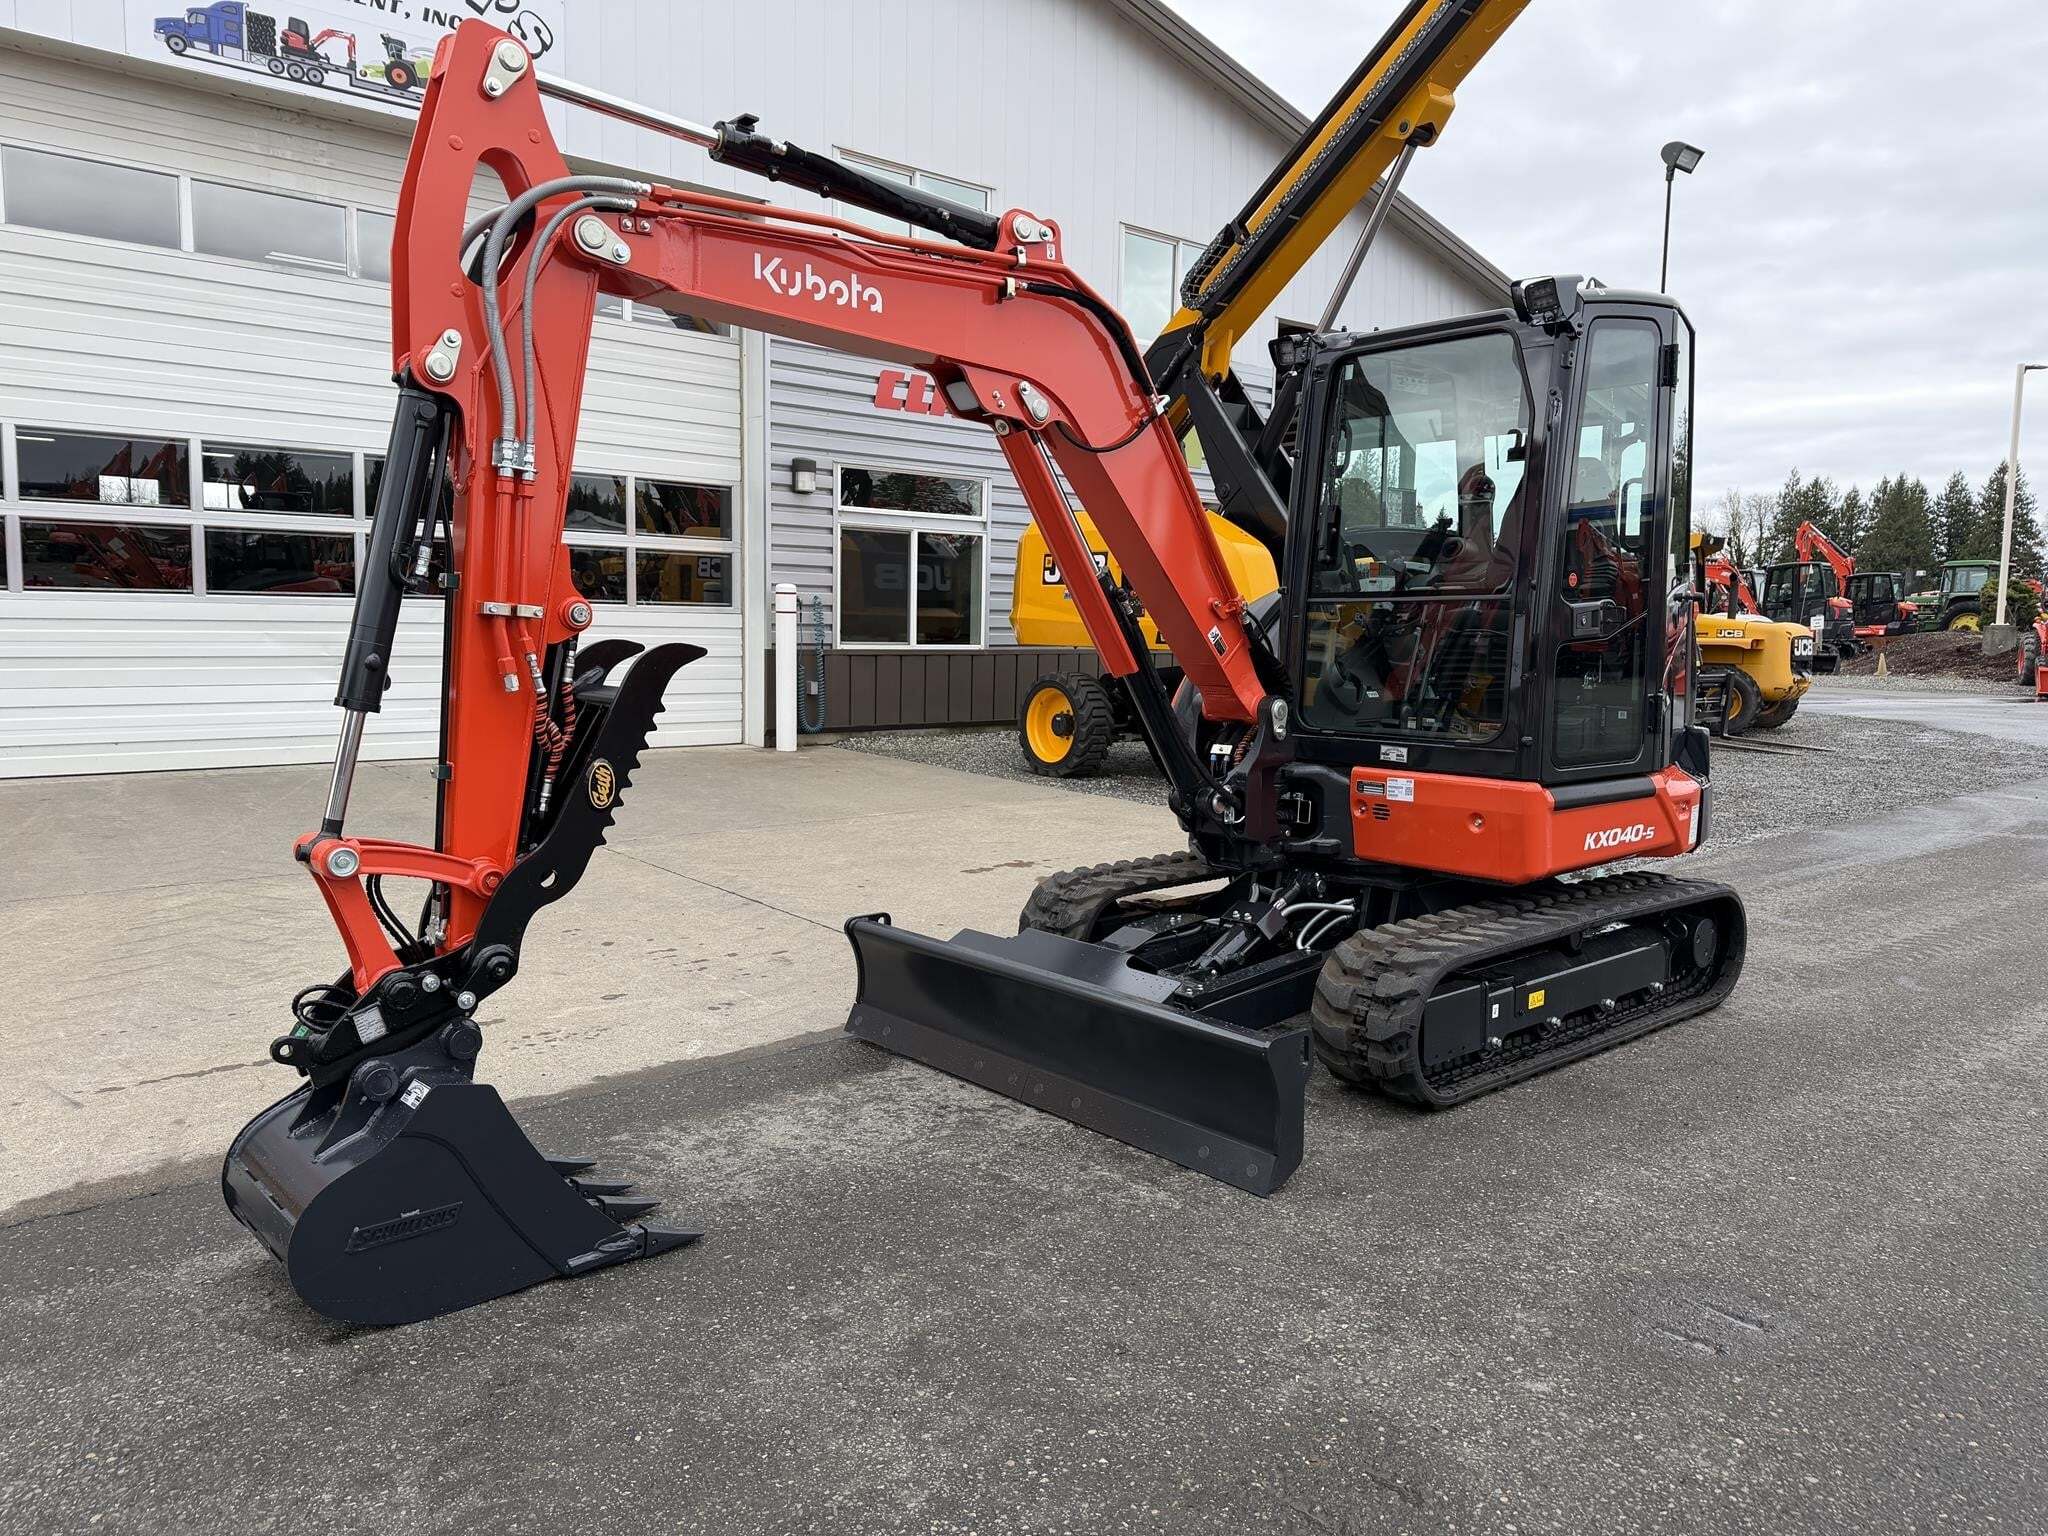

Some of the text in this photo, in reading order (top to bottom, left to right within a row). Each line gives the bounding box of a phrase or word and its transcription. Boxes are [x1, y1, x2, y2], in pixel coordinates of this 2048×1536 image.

[754, 252, 883, 313] Kubota
[1716, 629, 1744, 637] JCB
[1794, 638, 1813, 656] JCB
[1584, 824, 1655, 850] KX040-5
